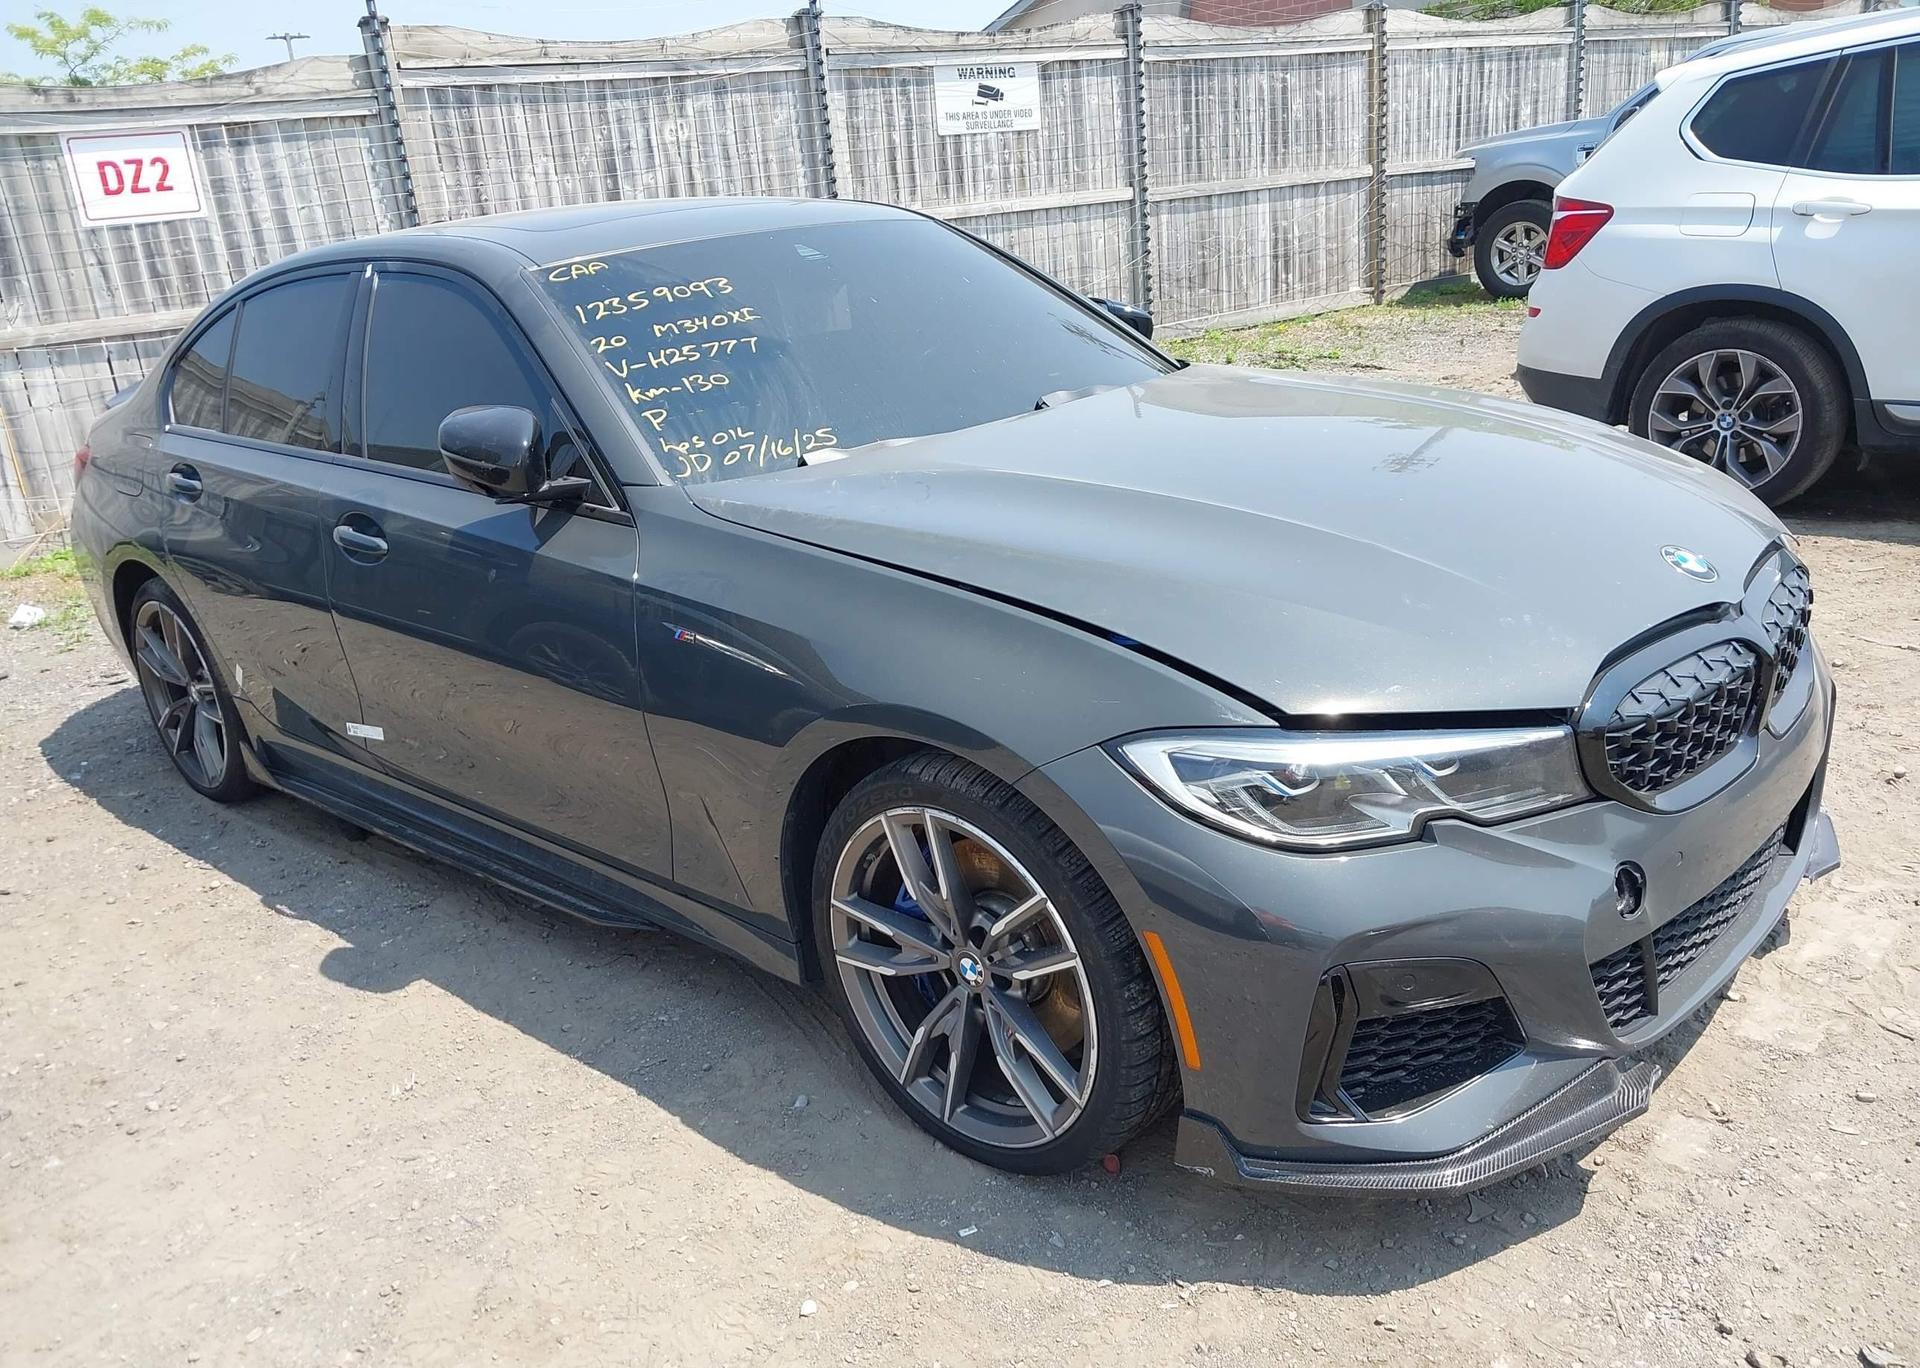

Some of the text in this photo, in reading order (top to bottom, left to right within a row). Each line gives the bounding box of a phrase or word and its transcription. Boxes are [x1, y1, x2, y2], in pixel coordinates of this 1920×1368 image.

[957, 67, 1016, 80] WARNING
[945, 109, 1033, 121] THIS AREA IS UNDER VIDEO
[965, 119, 1014, 130] SURVEILLANCE
[96, 156, 174, 196] DZ2
[548, 261, 609, 282] CAA
[590, 335, 627, 354] 20
[641, 408, 668, 432] P
[723, 427, 838, 468] 07/16/25
